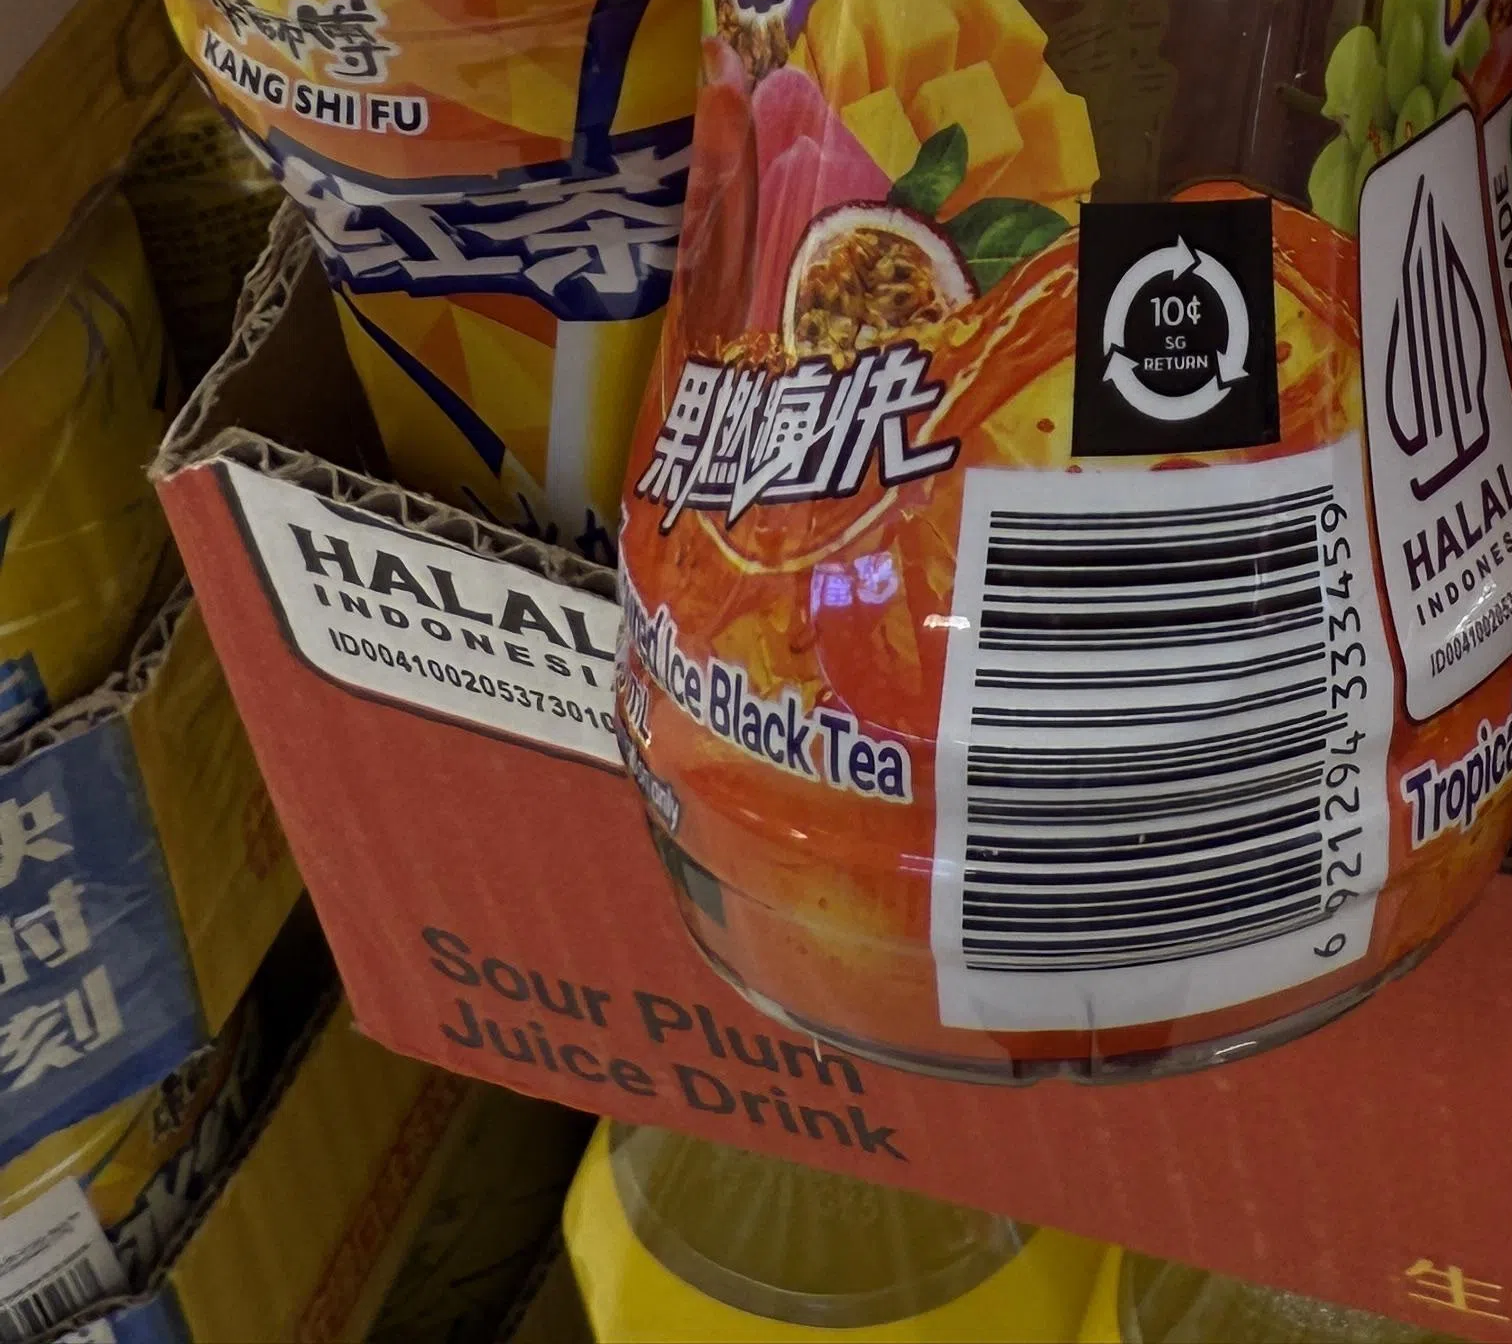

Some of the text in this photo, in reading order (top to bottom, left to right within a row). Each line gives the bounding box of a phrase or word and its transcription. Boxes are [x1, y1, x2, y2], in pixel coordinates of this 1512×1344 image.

[204, 30, 423, 132] KANG SHI FU
[1143, 355, 1209, 371] RETURN
[1149, 295, 1202, 327] 10¢
[1165, 335, 1187, 350] SG
[288, 523, 617, 663] HALAL
[312, 583, 617, 692] INDONESI
[665, 627, 703, 718] Ice
[708, 663, 814, 776] Black
[819, 713, 905, 799] Tea
[1313, 502, 1368, 959] 6 921294 333459
[421, 925, 867, 1095] Sour Plum
[439, 997, 911, 1164] Juice Drink
